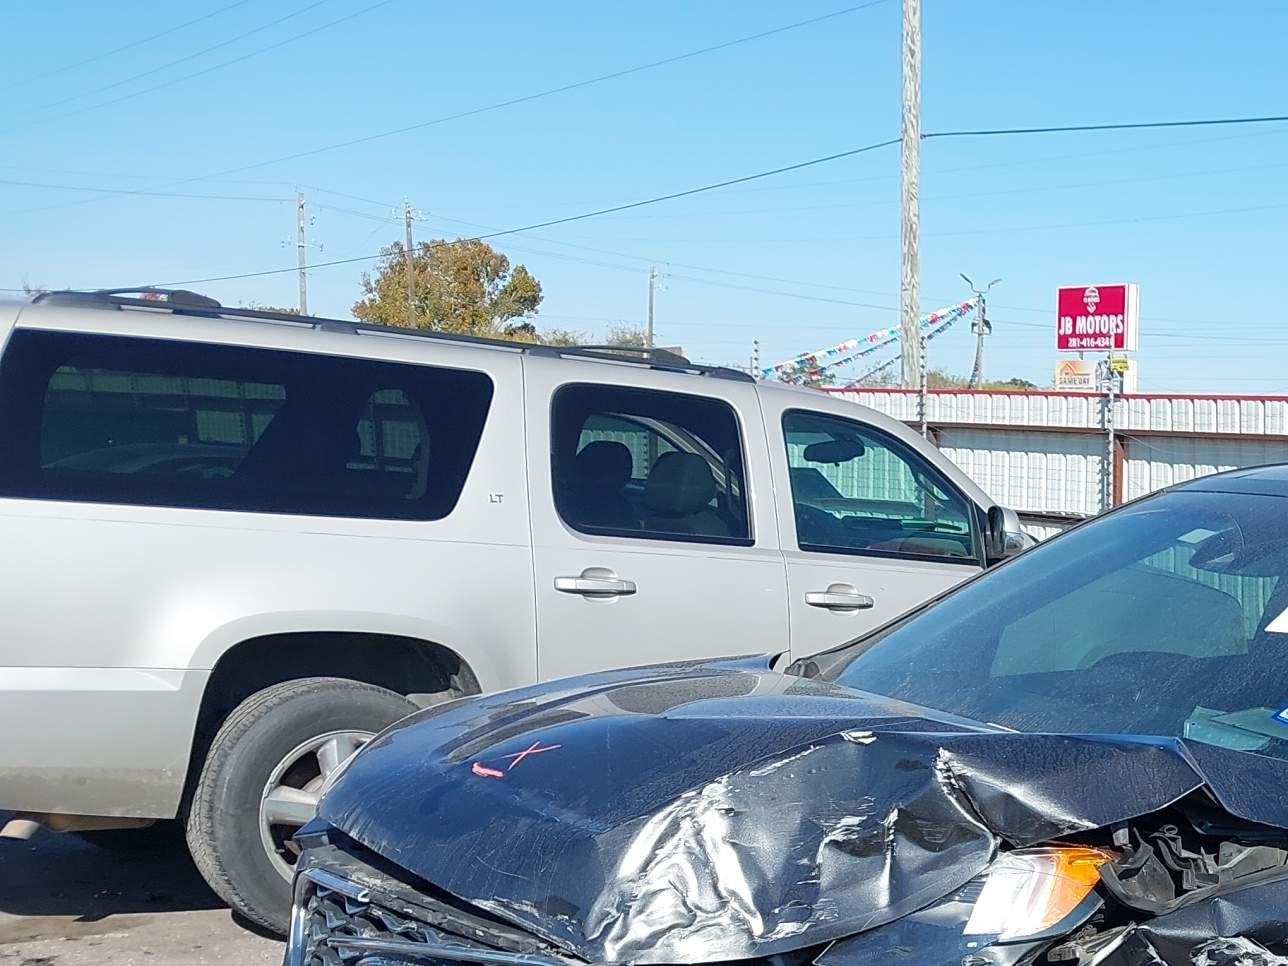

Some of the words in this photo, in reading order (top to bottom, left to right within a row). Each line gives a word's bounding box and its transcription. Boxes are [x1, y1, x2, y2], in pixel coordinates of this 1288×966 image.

[1059, 315, 1073, 335] JB
[1075, 314, 1124, 335] MOTORS
[489, 493, 504, 504] LT
